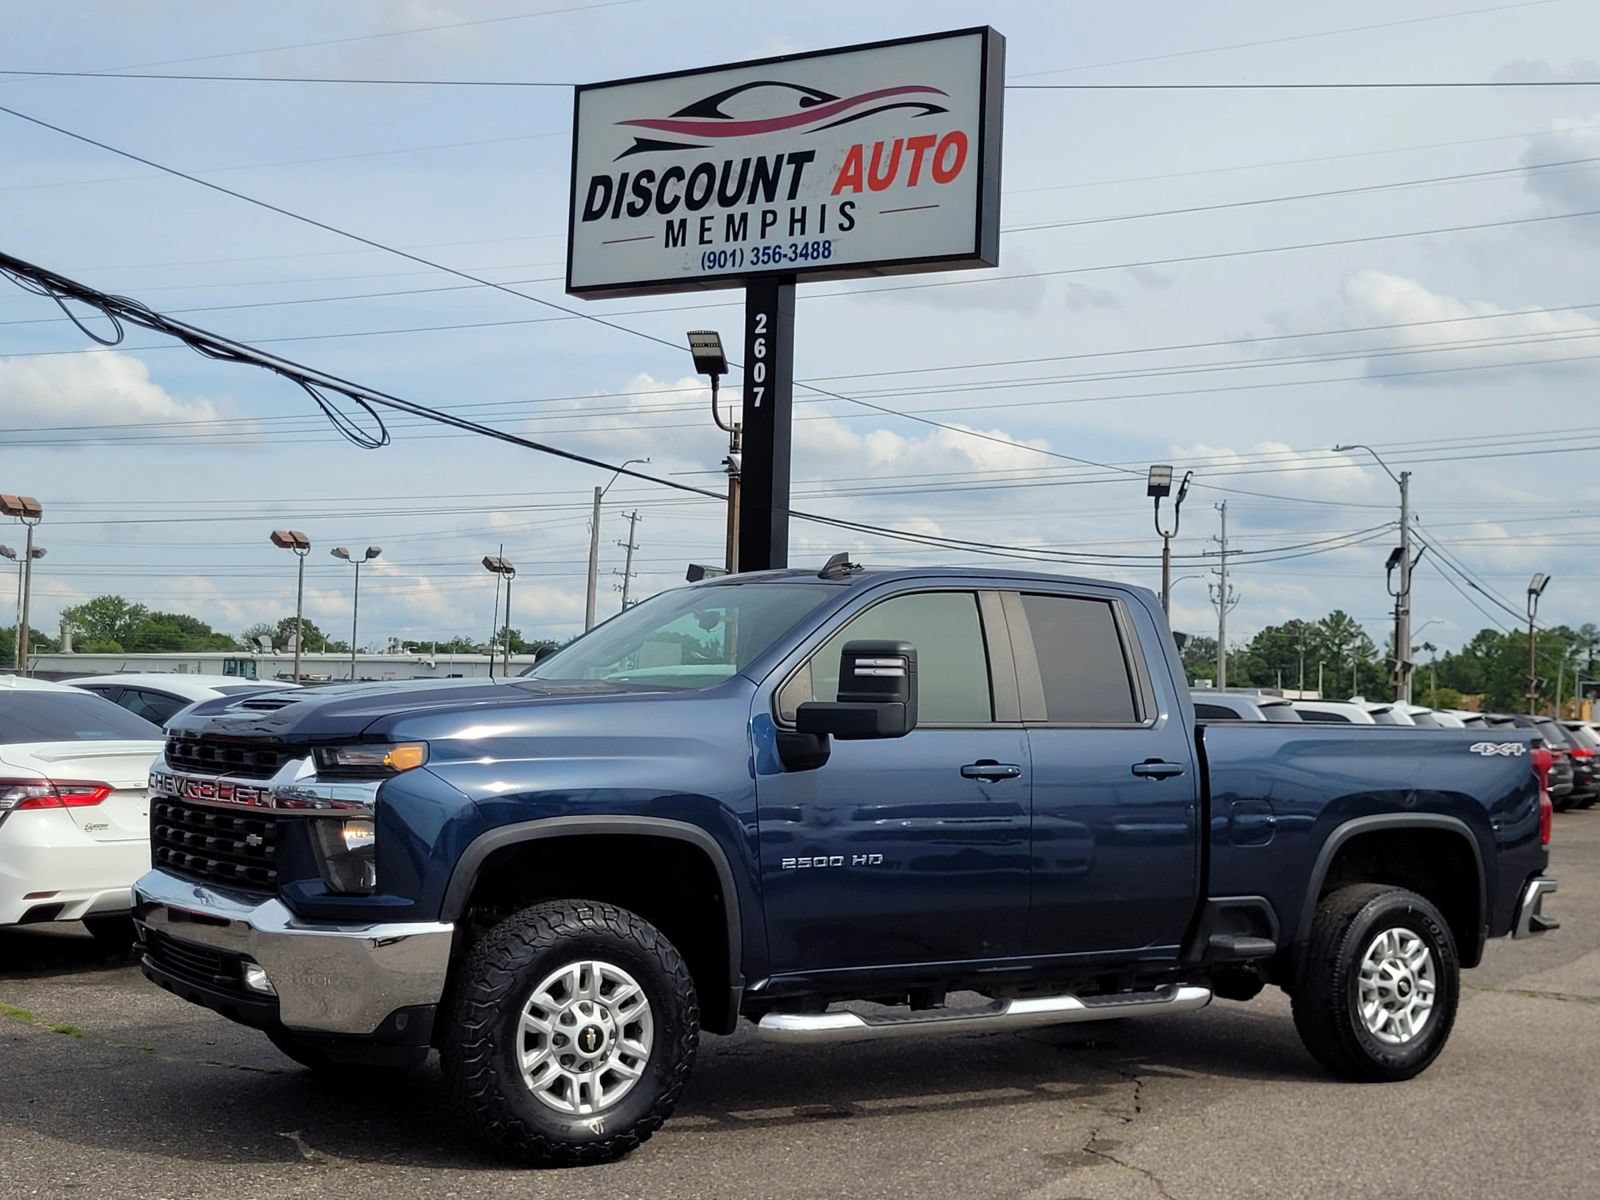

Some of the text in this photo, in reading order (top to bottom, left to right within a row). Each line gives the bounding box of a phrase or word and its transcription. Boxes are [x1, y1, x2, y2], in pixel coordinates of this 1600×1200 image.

[582, 131, 968, 222] DISCOUNT AUTO
[665, 201, 856, 248] MEMPHIS
[701, 240, 832, 271] (901) 356-3488
[753, 313, 767, 407] 2607
[149, 771, 270, 806] CHEVROLET
[782, 854, 883, 869] 2500 HD
